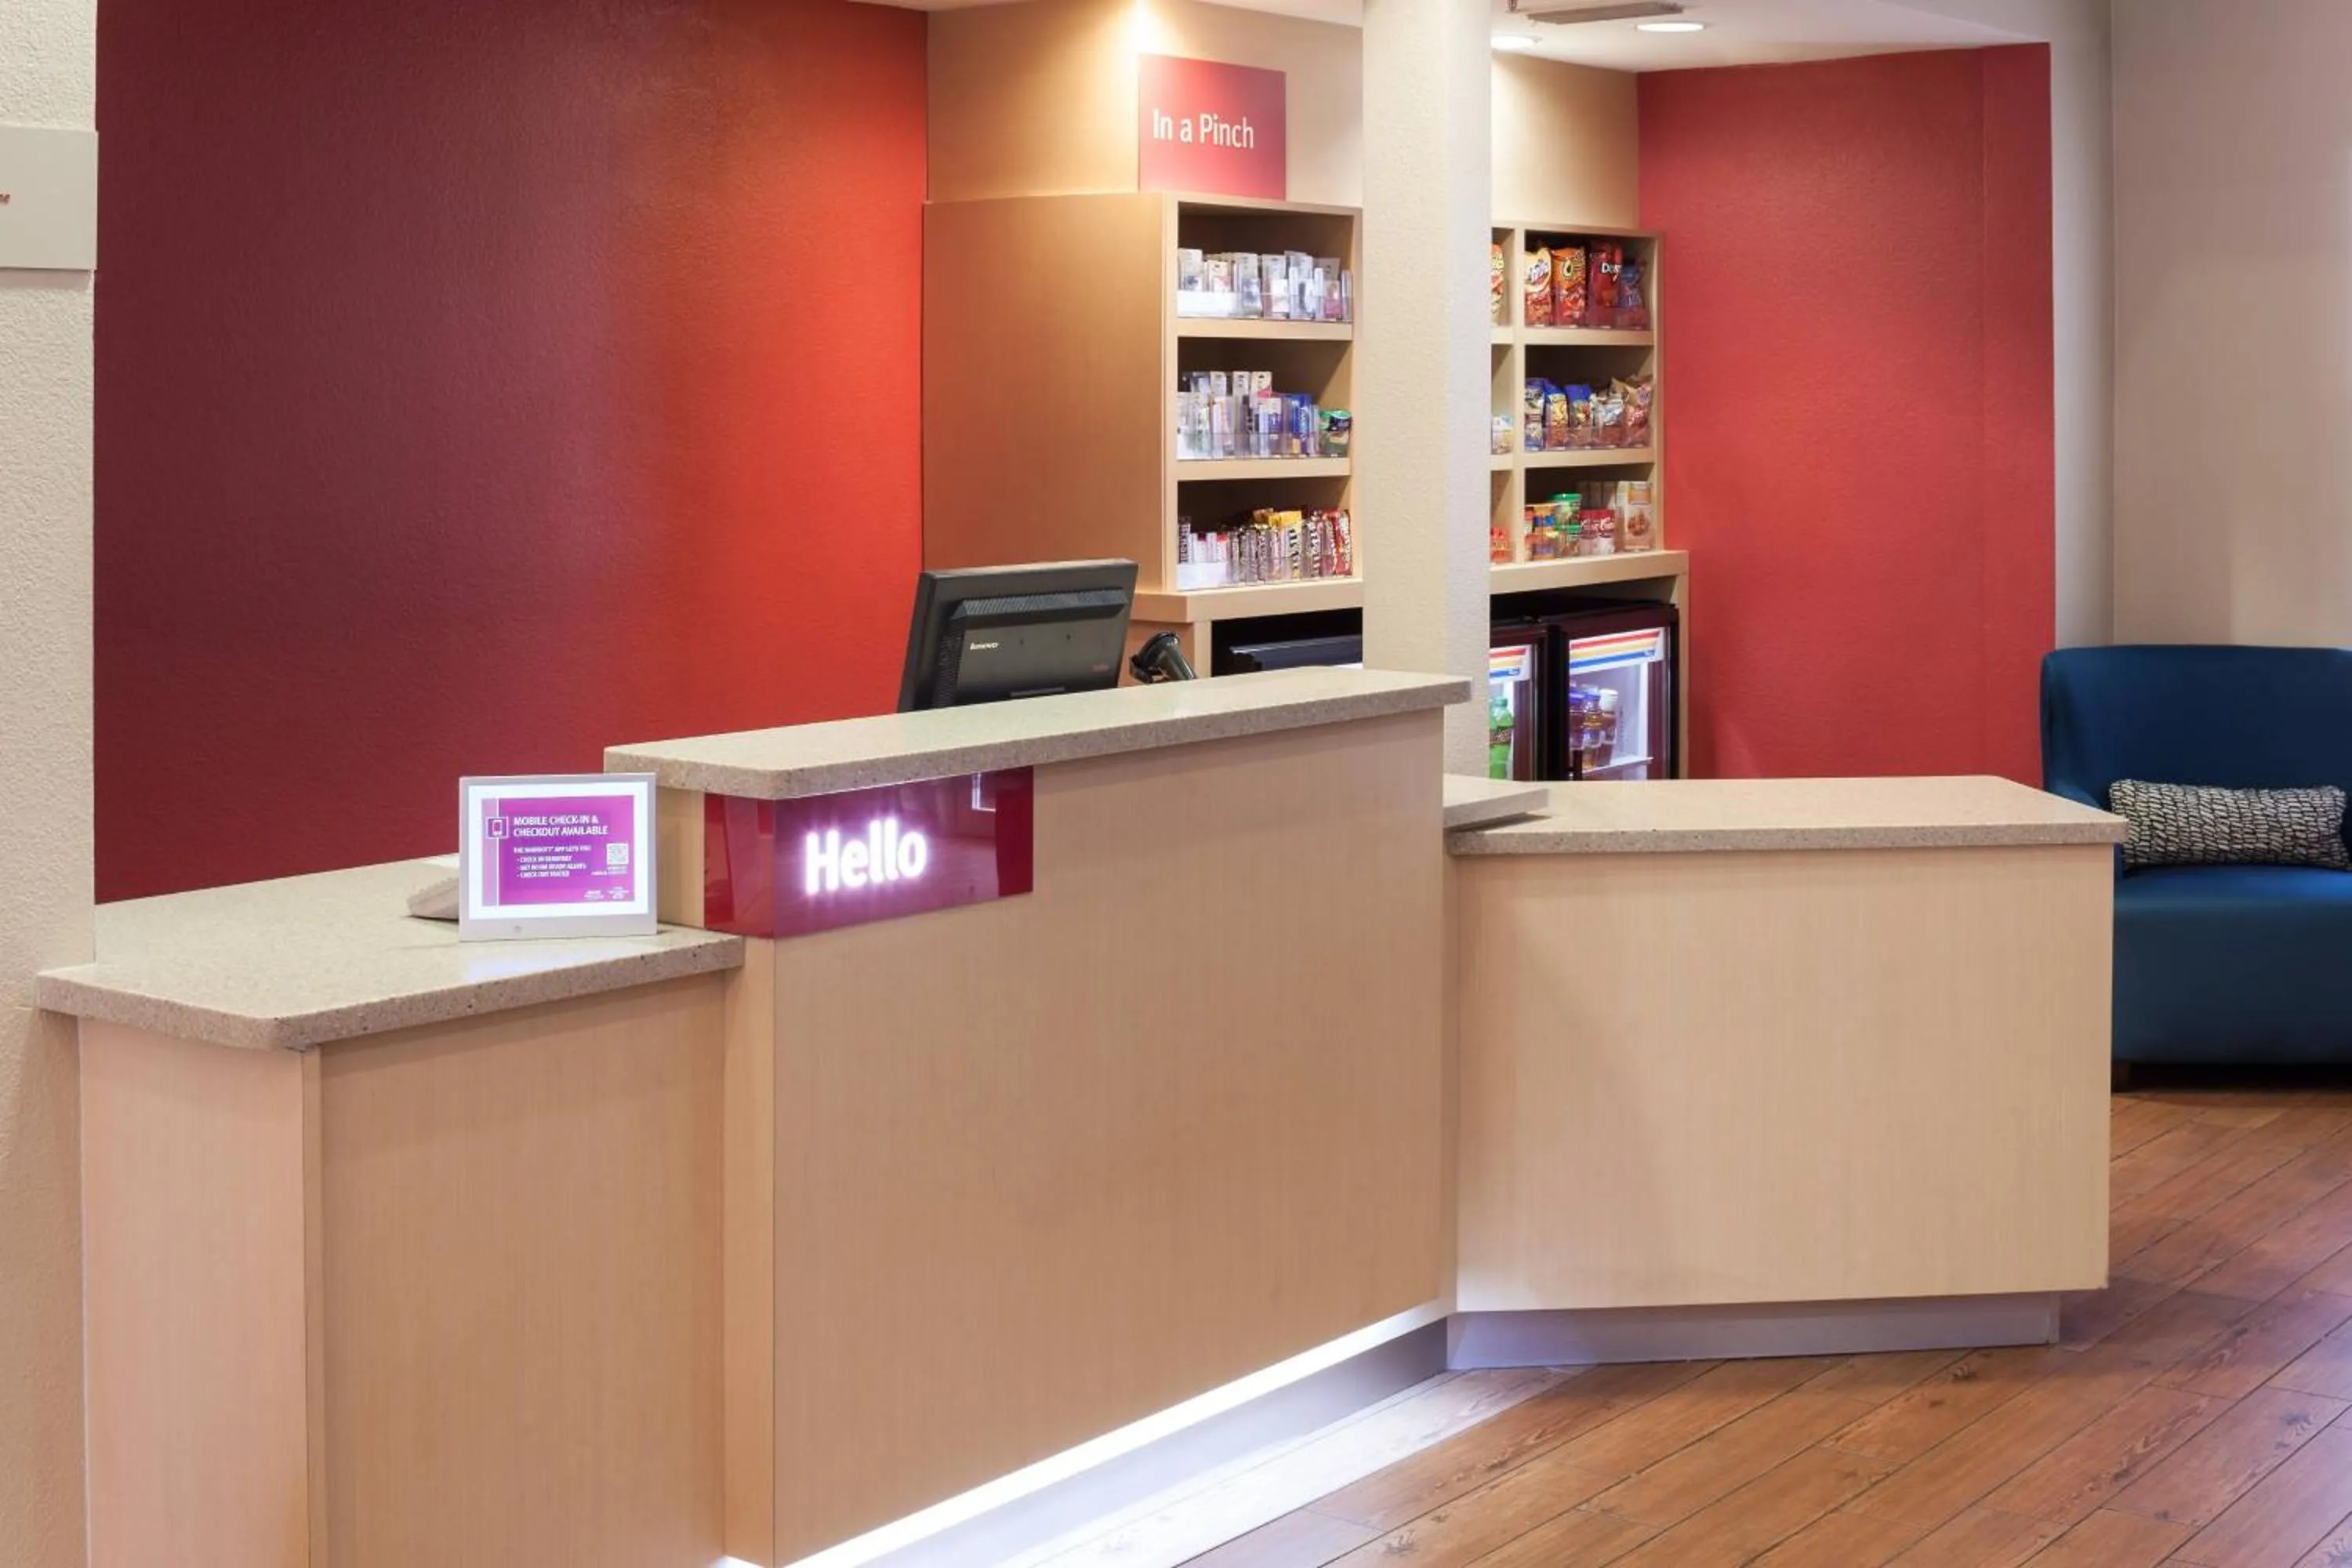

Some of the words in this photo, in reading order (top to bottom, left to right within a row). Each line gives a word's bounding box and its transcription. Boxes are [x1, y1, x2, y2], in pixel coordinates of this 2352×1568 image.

[1152, 108, 1173, 140] In
[1180, 118, 1192, 143] a
[1200, 113, 1254, 149] Pinch
[514, 816, 547, 826] MOBILE
[549, 815, 590, 825] CHECK-IN
[514, 827, 560, 837] CHECKOUT
[561, 826, 608, 836] AVAILABLE
[806, 816, 927, 895] Hello
